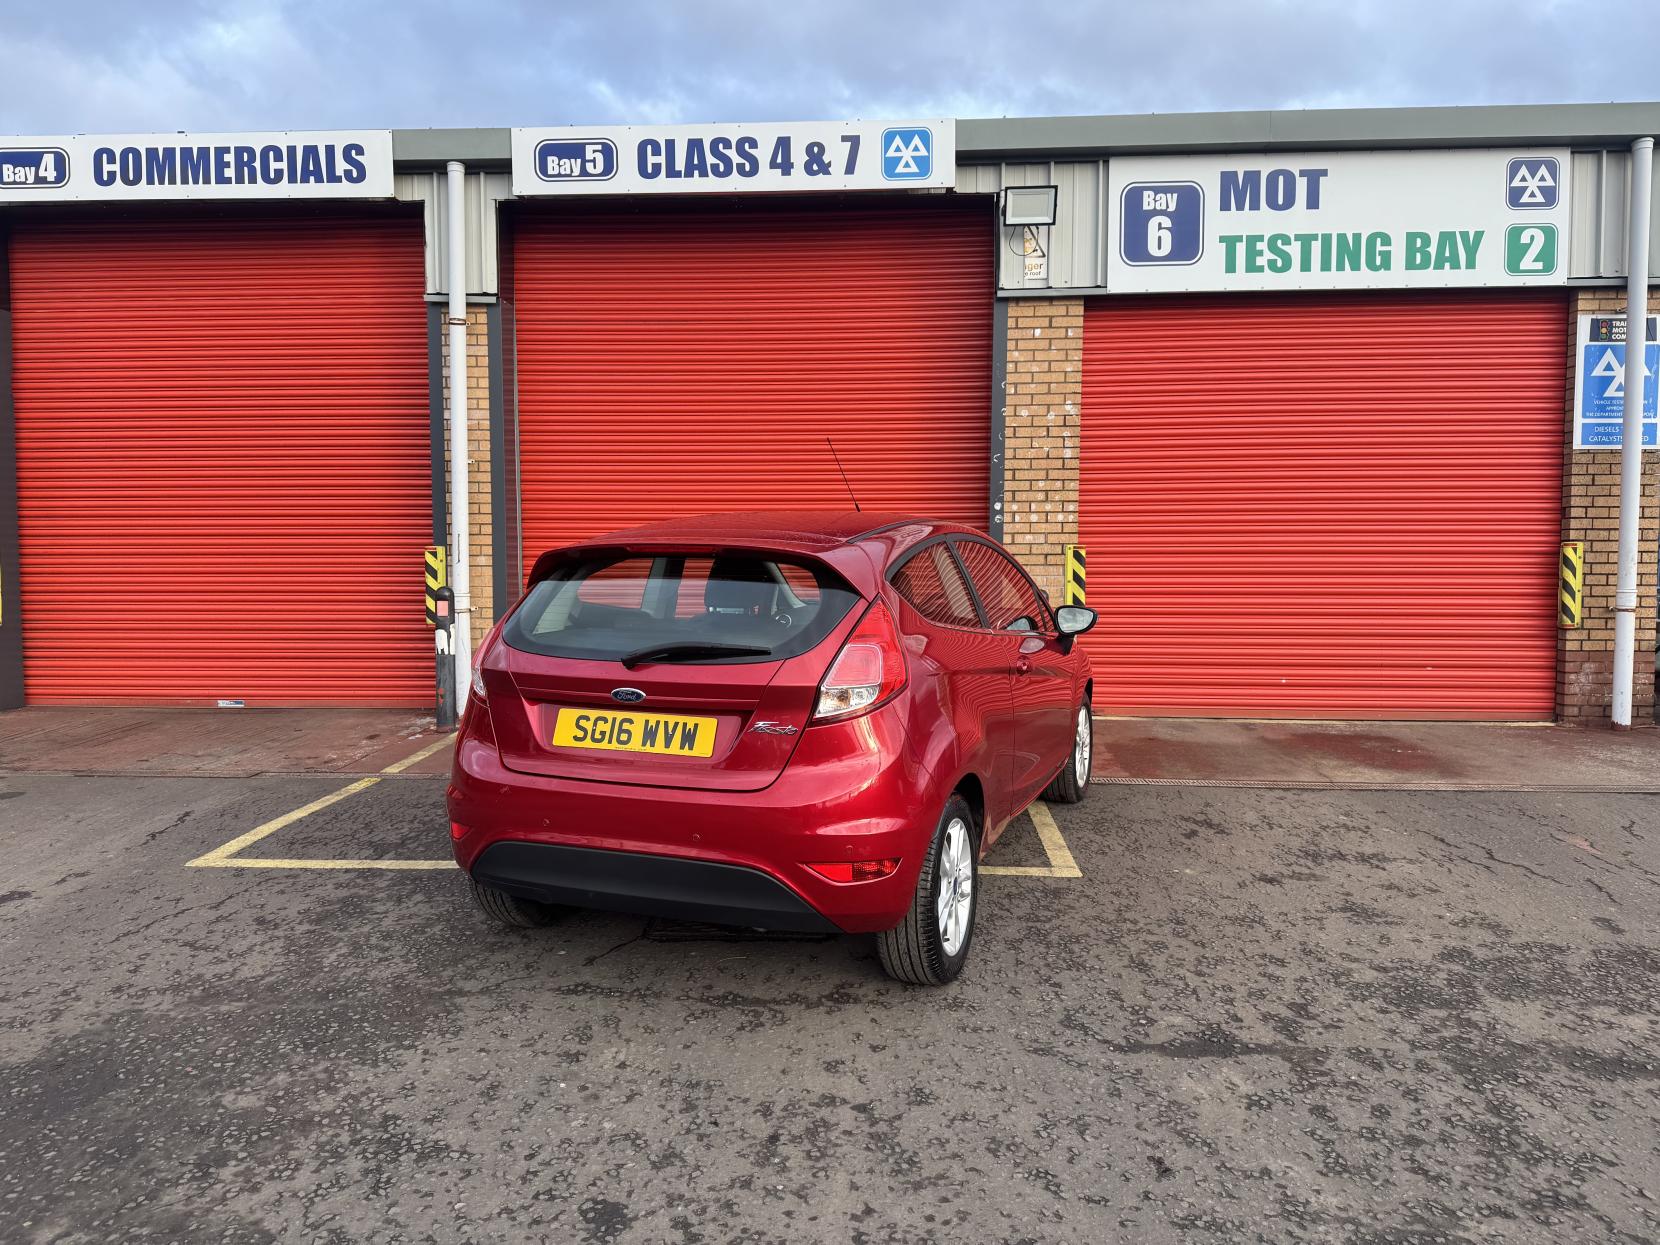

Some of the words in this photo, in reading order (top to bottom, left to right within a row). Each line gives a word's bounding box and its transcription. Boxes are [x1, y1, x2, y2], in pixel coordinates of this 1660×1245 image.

[2, 164, 36, 184] Bay
[38, 153, 57, 182] 4
[93, 143, 367, 187] COMMERCIALS
[547, 155, 582, 178] Bay
[584, 144, 605, 175] 5
[636, 136, 760, 180] CLASS
[769, 135, 795, 176] 4
[803, 140, 832, 176] &
[840, 134, 861, 176] 7
[1142, 190, 1178, 212] Bay
[1219, 168, 1329, 212] MOT
[1147, 215, 1173, 257] 6
[1218, 232, 1392, 274] TESTING
[1404, 230, 1486, 271] BAY
[1519, 227, 1546, 270] 2
[572, 714, 633, 746] SG16
[641, 719, 699, 751] WVW
